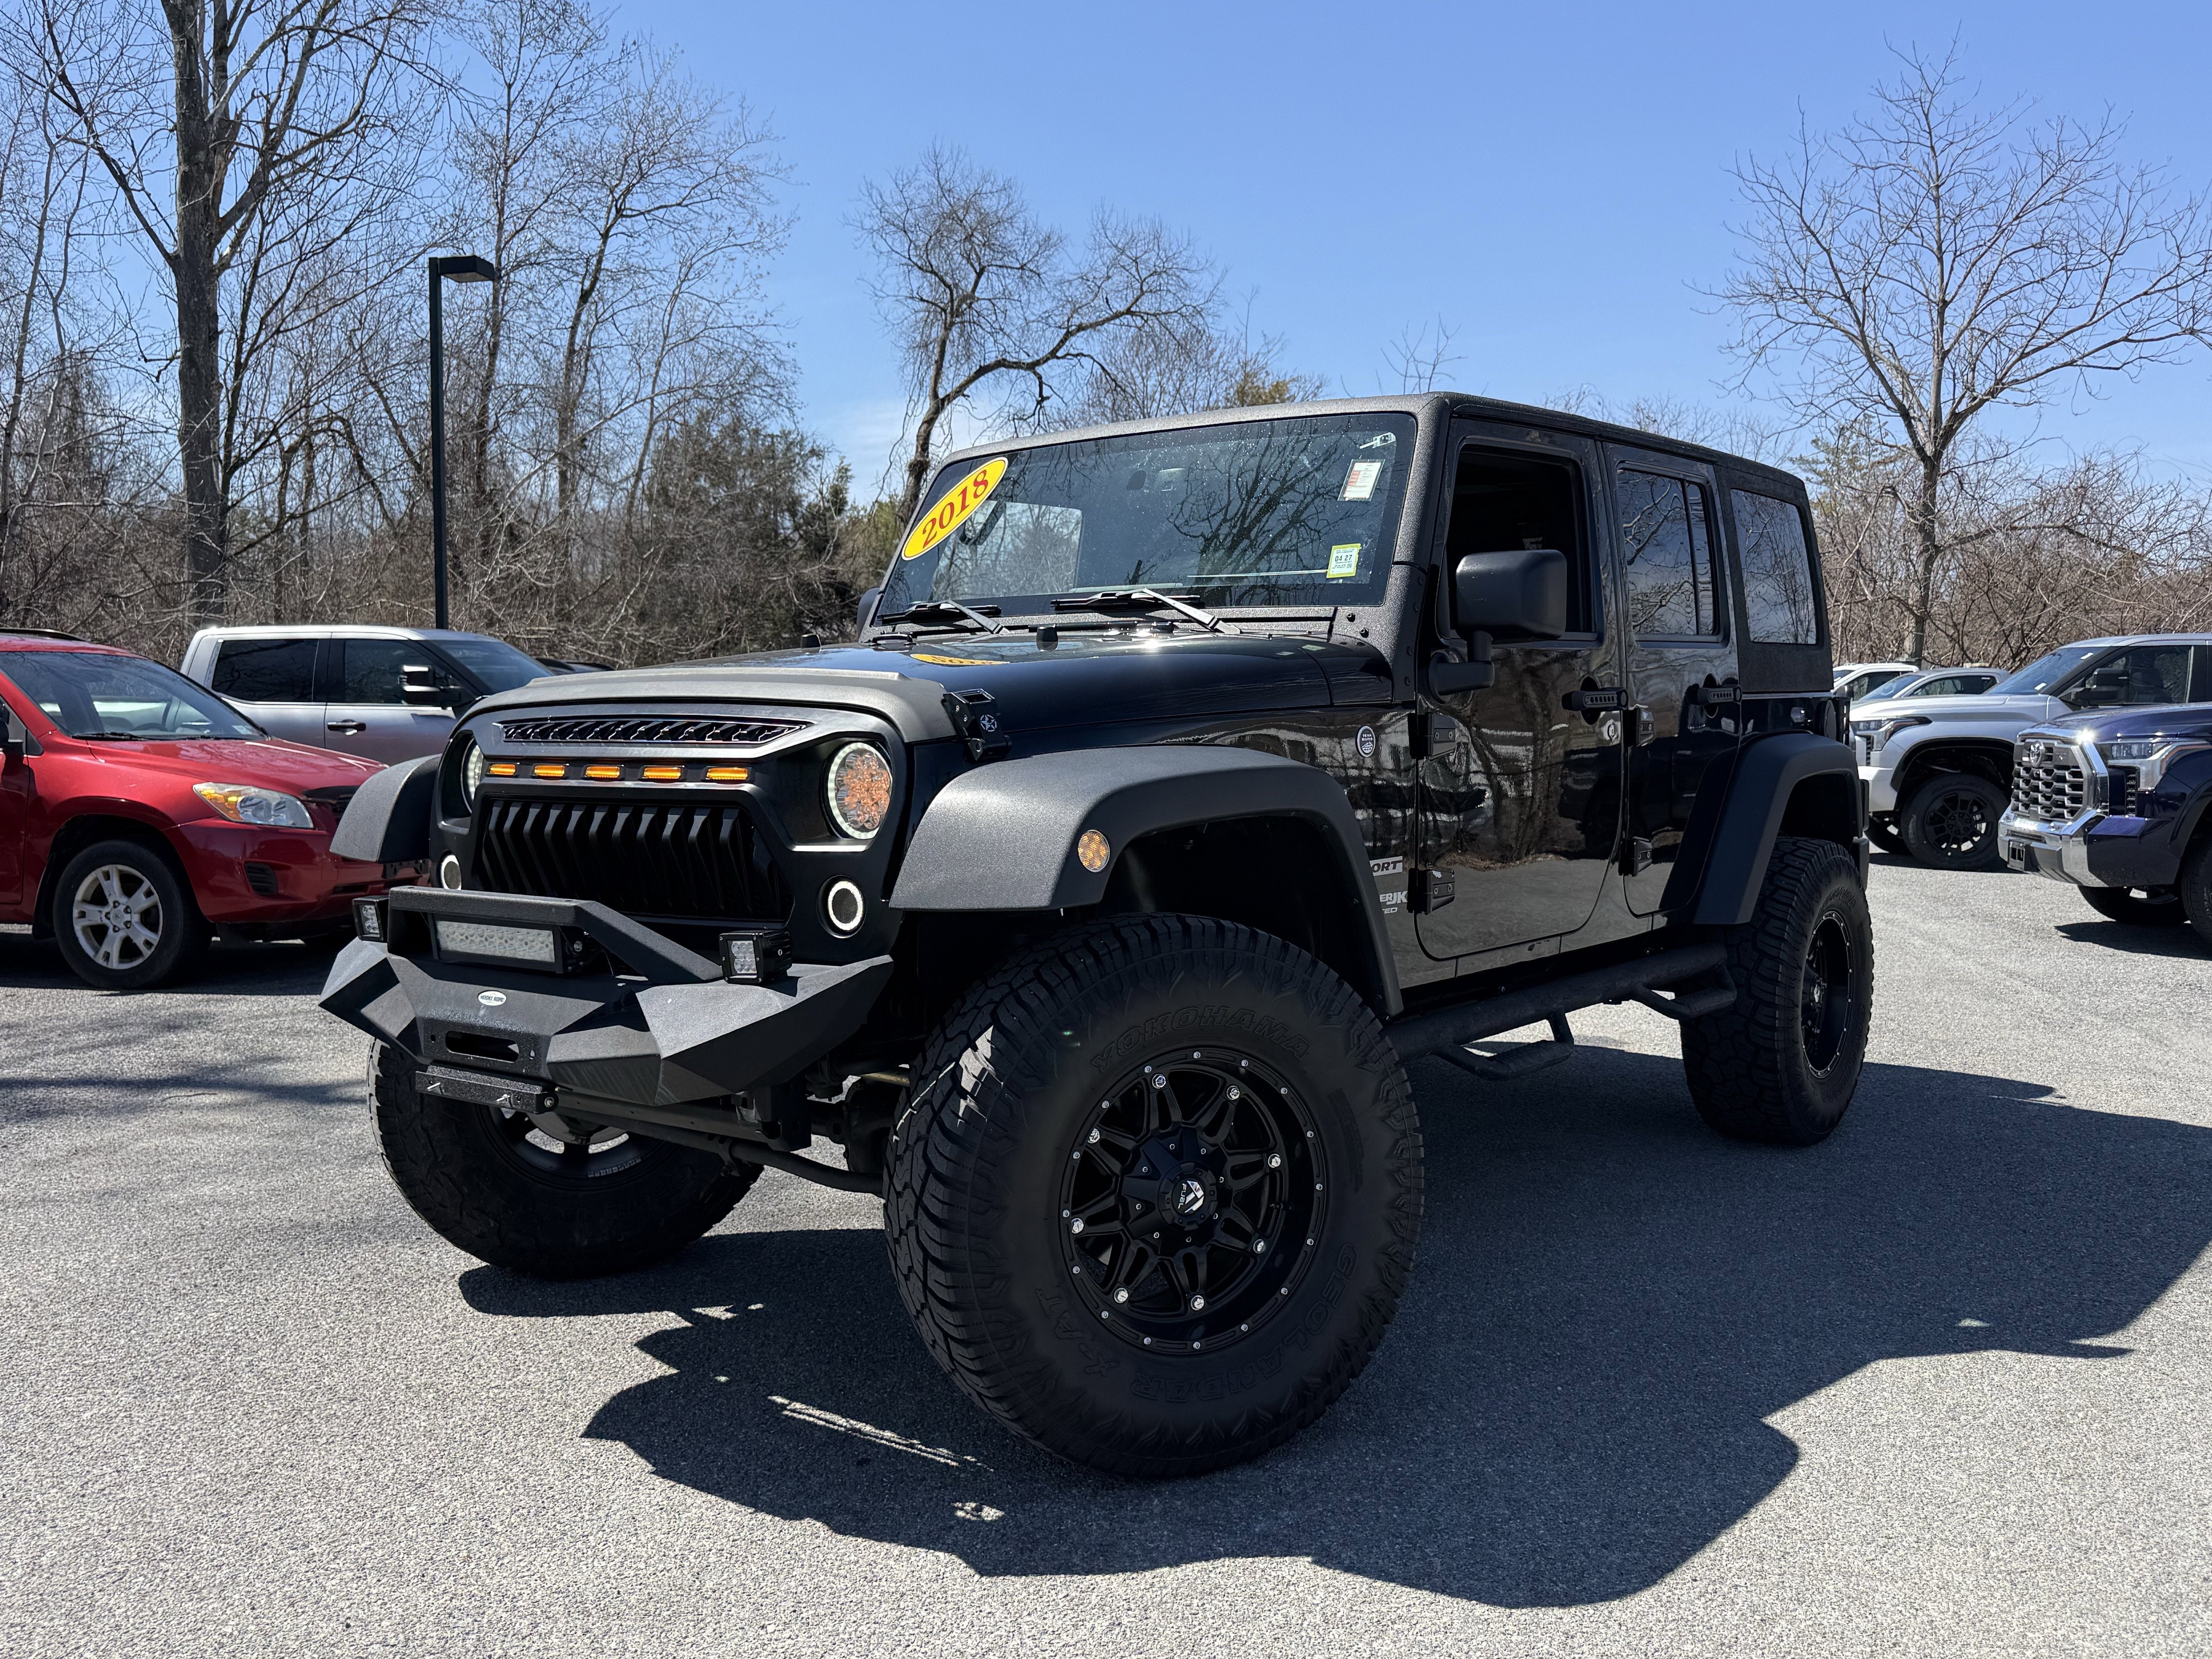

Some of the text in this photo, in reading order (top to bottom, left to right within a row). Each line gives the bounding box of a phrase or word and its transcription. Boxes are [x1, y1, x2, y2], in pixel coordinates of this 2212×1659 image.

[922, 470, 989, 549] 2018
[1091, 1005, 1312, 1073] YOKOHAMA
[1178, 1183, 1187, 1209] FUEL
[1131, 1243, 1358, 1403] GEOLANDAR
